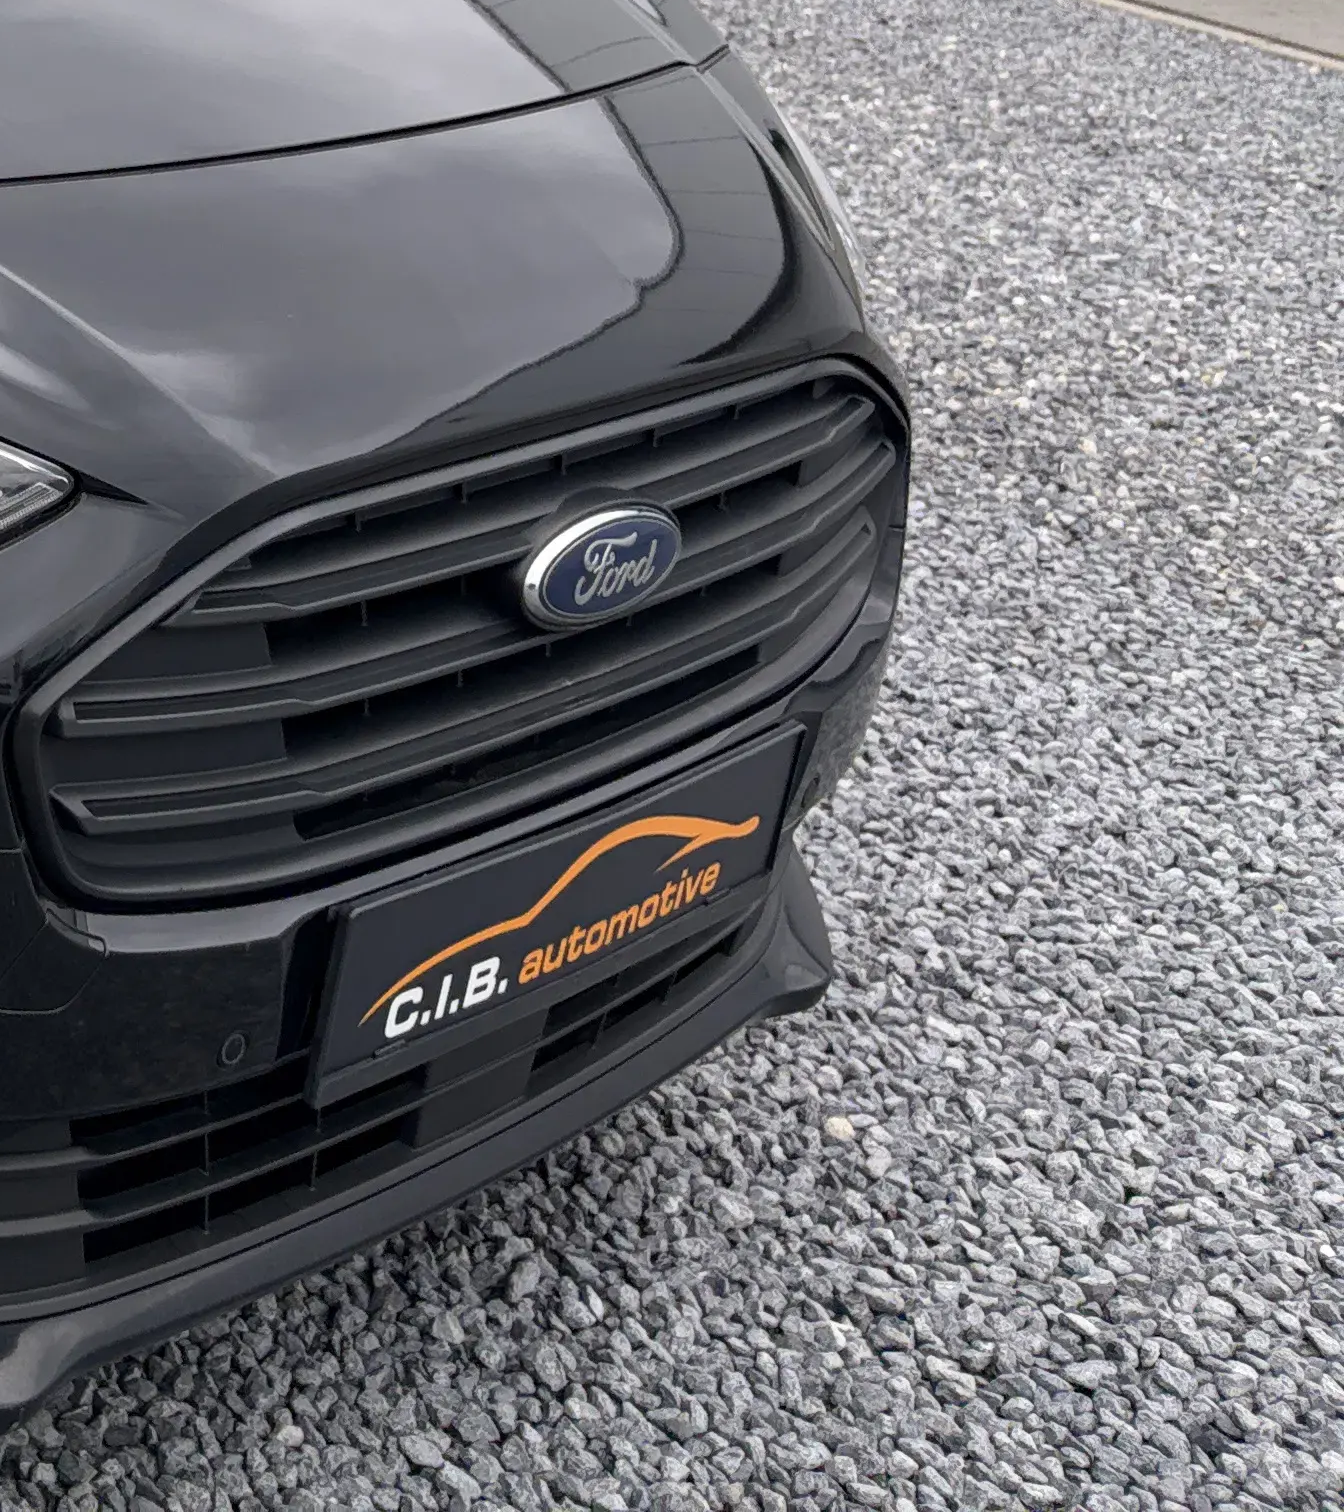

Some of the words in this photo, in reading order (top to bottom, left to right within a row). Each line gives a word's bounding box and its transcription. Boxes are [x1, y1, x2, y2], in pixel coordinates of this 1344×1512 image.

[574, 531, 658, 606] Ford
[384, 956, 509, 1039] C.I.B.
[517, 861, 722, 985] automotive
